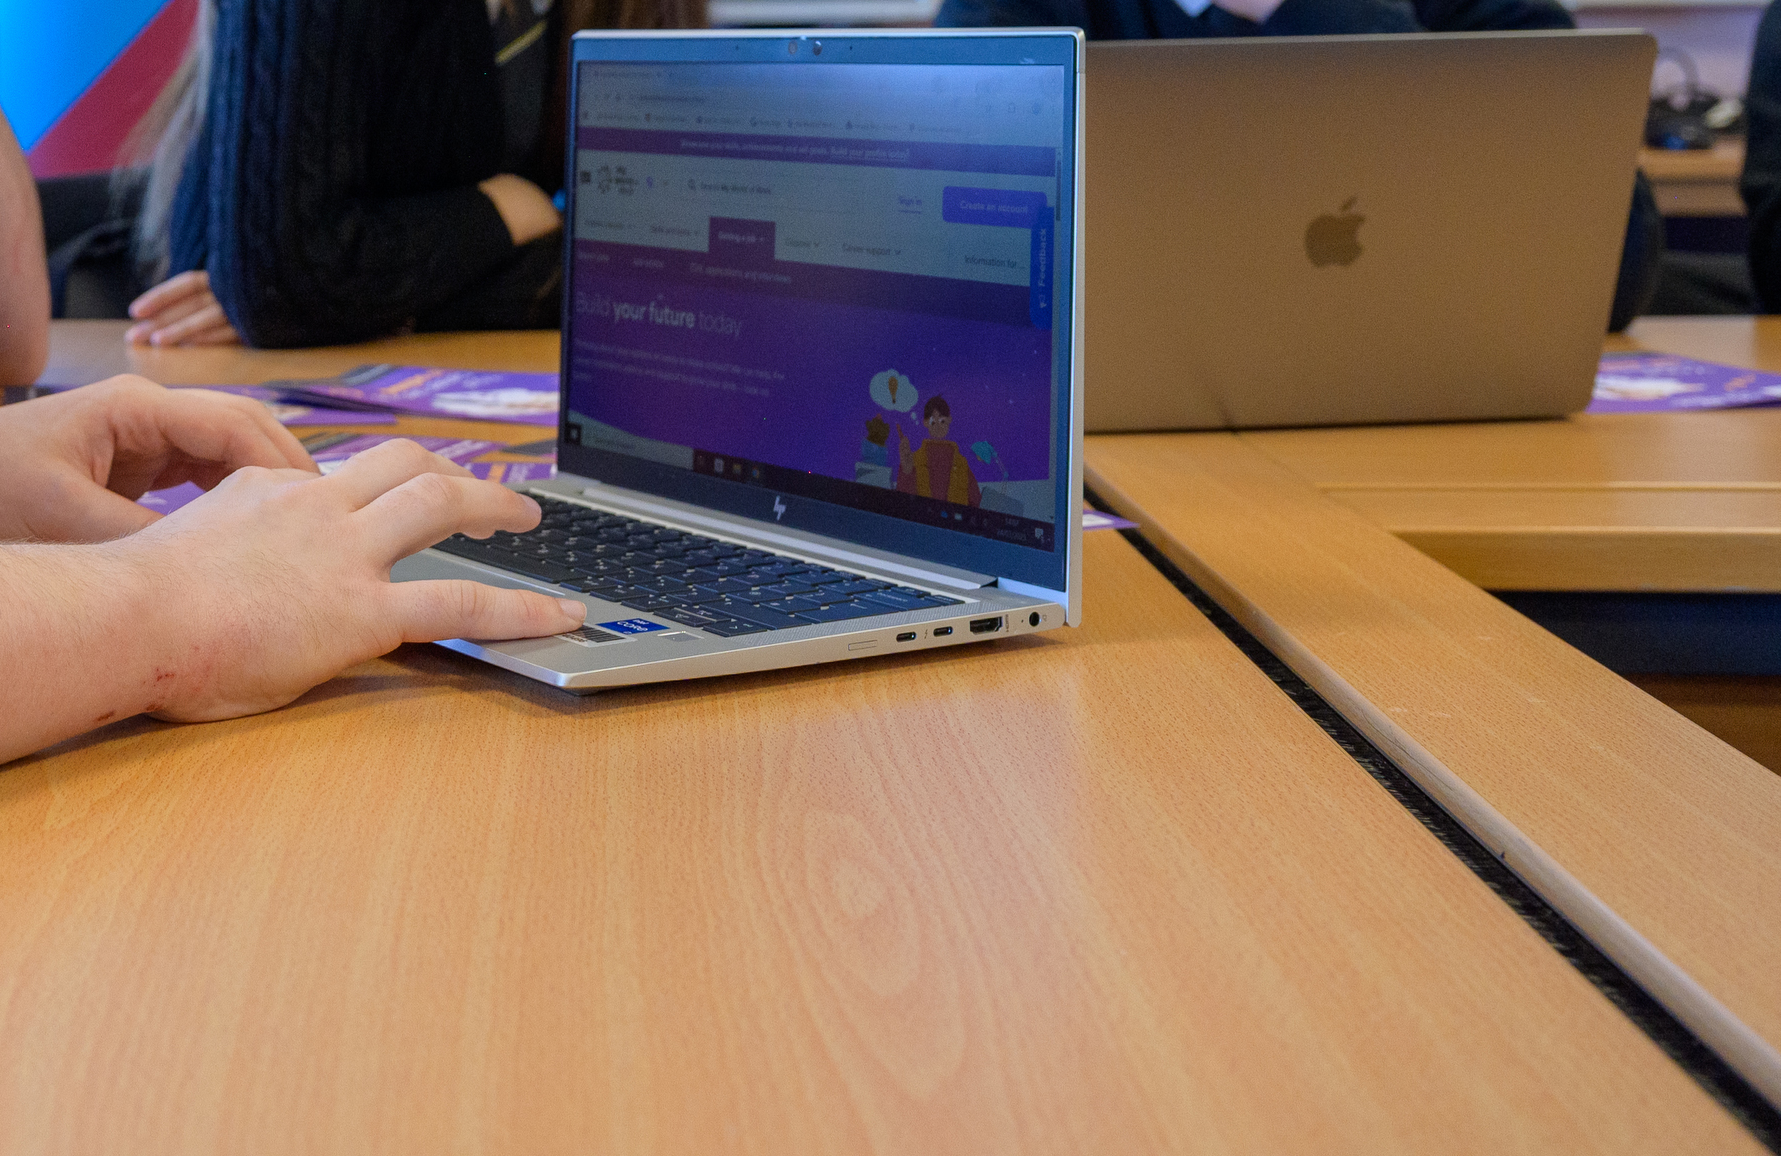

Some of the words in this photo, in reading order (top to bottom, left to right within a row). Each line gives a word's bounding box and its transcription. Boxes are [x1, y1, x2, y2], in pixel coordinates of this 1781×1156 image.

[965, 255, 1006, 268] Information
[1039, 228, 1047, 287] Feedback
[613, 302, 646, 324] your
[649, 300, 695, 329] future
[699, 311, 741, 337] today
